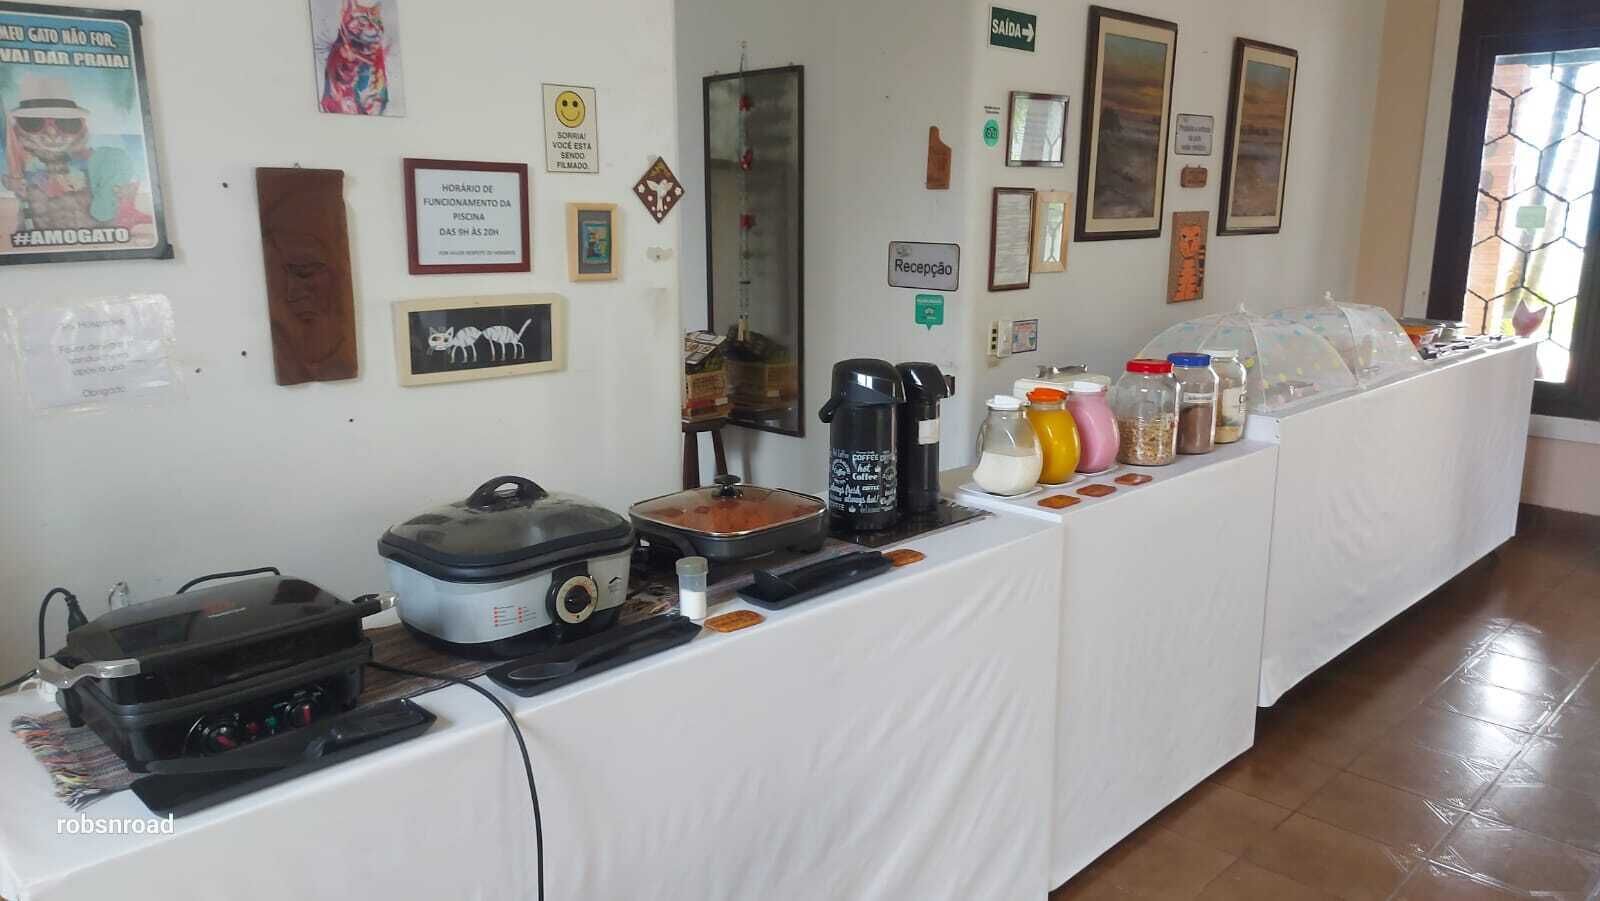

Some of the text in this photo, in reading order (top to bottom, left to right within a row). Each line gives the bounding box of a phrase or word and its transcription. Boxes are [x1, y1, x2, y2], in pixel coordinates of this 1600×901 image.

[991, 17, 1022, 39] SAÍDA
[28, 27, 59, 43] GATO
[62, 27, 87, 46] NÃO
[0, 48, 130, 69] VAI DAR PRAIA!
[560, 151, 585, 160] SENDO
[441, 182, 494, 194] HORÁRIO DE
[423, 198, 512, 208] FUNCIONAMENTO DA
[453, 212, 485, 221] PISCINA
[12, 228, 130, 247] #AMOGATO
[439, 227, 457, 237] DAS
[483, 228, 499, 237] 20H
[894, 258, 953, 279] Recepção
[852, 472, 878, 481] Coffee
